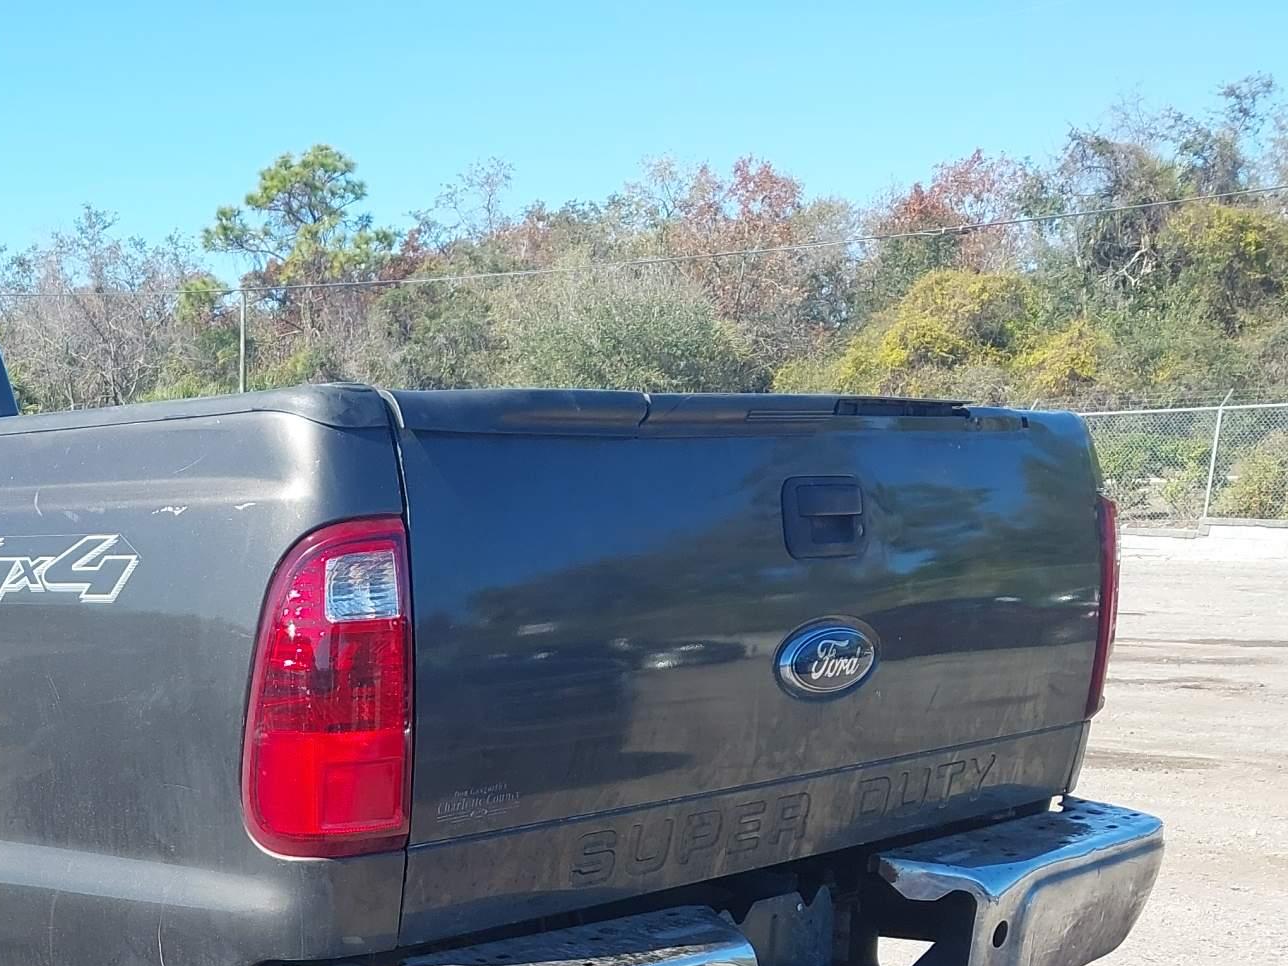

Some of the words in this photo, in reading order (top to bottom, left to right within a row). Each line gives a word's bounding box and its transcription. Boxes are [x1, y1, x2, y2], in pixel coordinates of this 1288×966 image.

[811, 639, 861, 680] Ford
[569, 791, 811, 886] SUPER
[849, 753, 997, 824] DUTY
